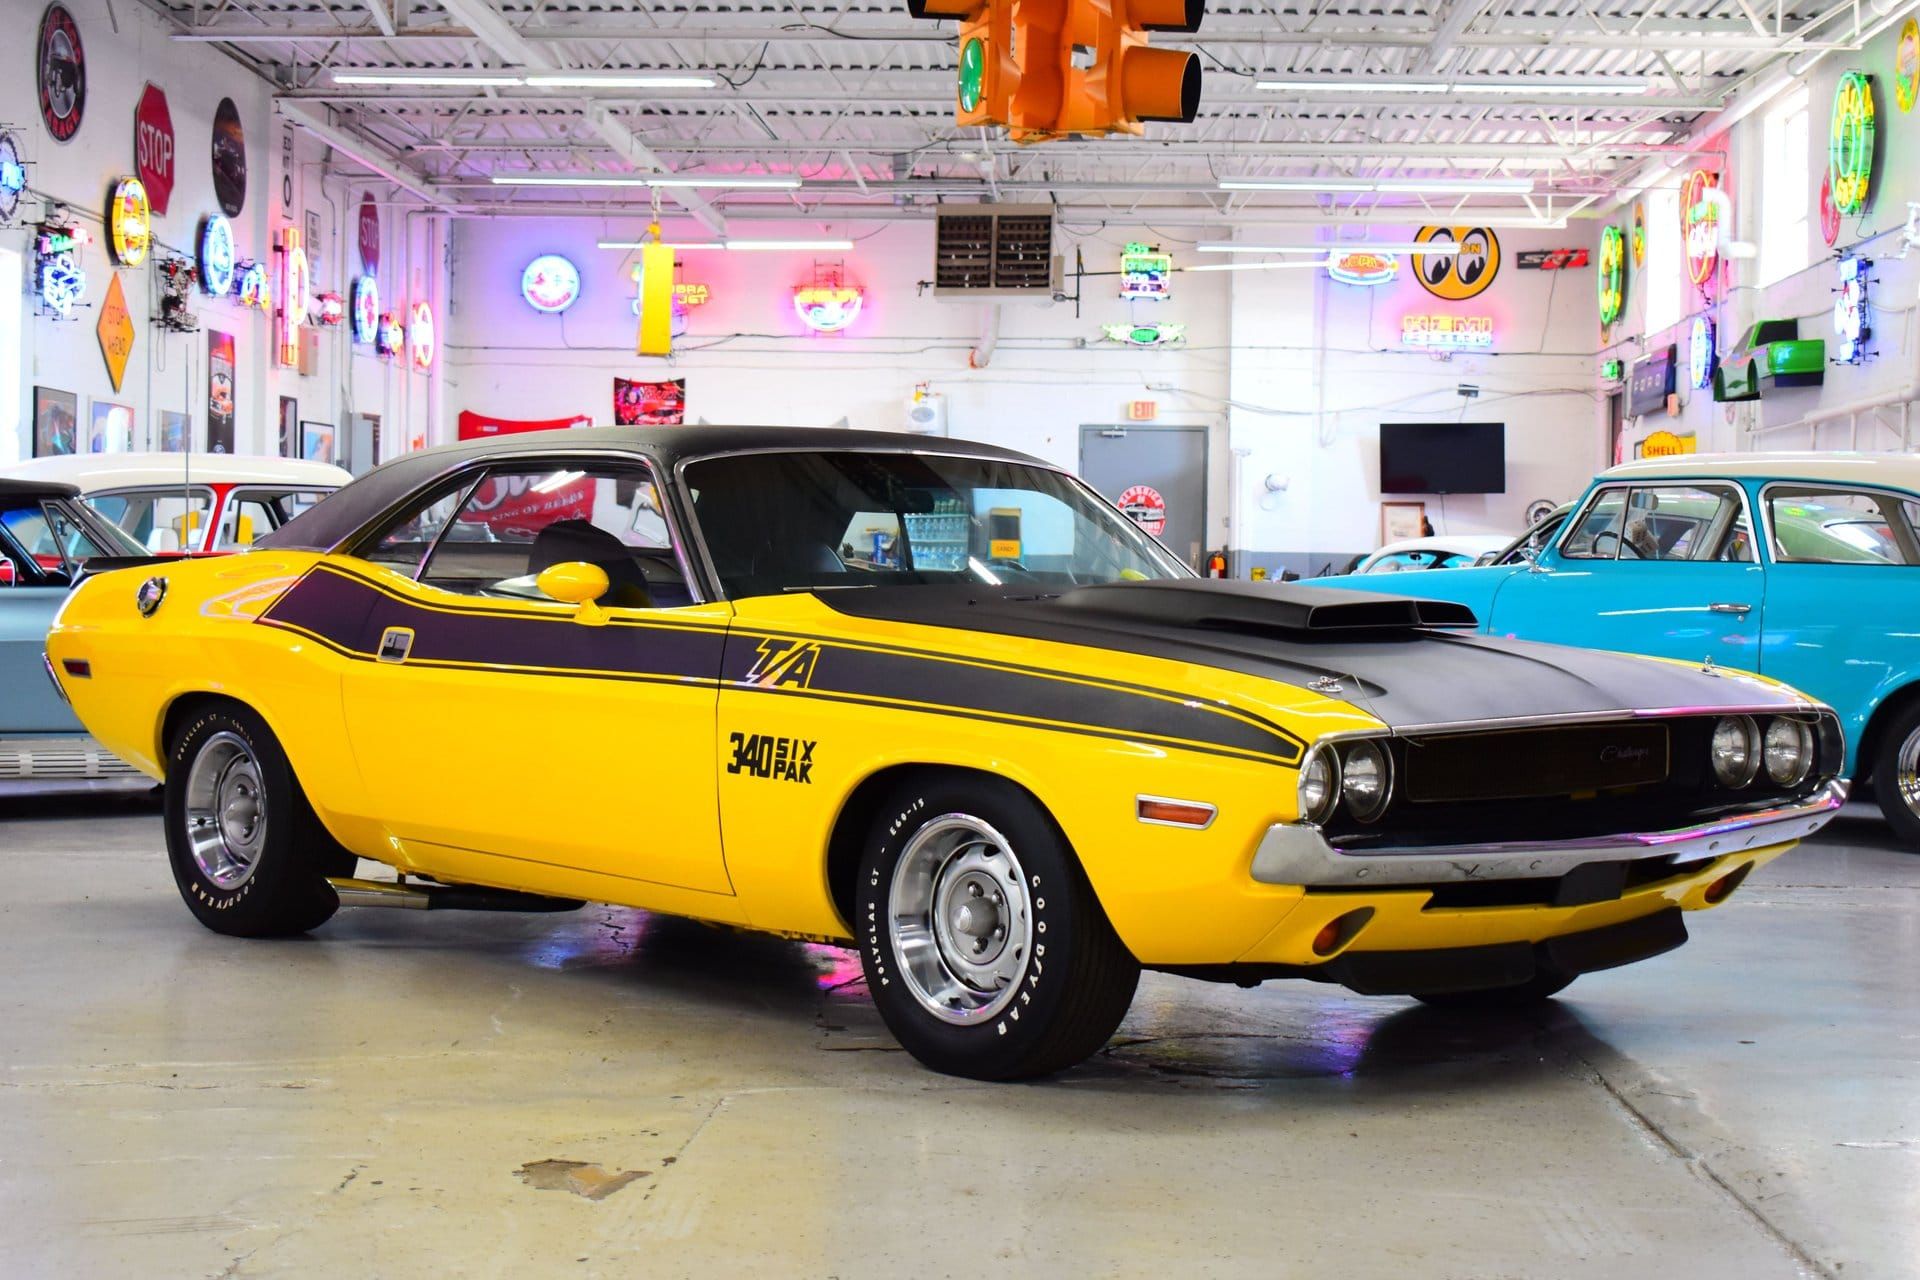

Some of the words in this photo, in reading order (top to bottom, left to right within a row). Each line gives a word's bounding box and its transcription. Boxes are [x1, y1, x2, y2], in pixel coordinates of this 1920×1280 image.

[140, 120, 172, 177] STOP
[361, 216, 379, 249] STOP
[1520, 251, 1586, 266] SRT
[672, 284, 708, 295] BRA
[678, 294, 708, 304] JET
[1134, 402, 1154, 419] EXIT
[1647, 446, 1677, 456] SHELL
[523, 502, 540, 513] OF
[727, 732, 774, 778] 340
[775, 738, 817, 762] SIX
[773, 758, 813, 784] PAK
[889, 797, 925, 837] E60-15
[871, 868, 880, 886] GT
[190, 876, 255, 909] GOODYEAR
[868, 902, 889, 986] POLYGLAS
[998, 874, 1047, 1036] GOODYEAR
